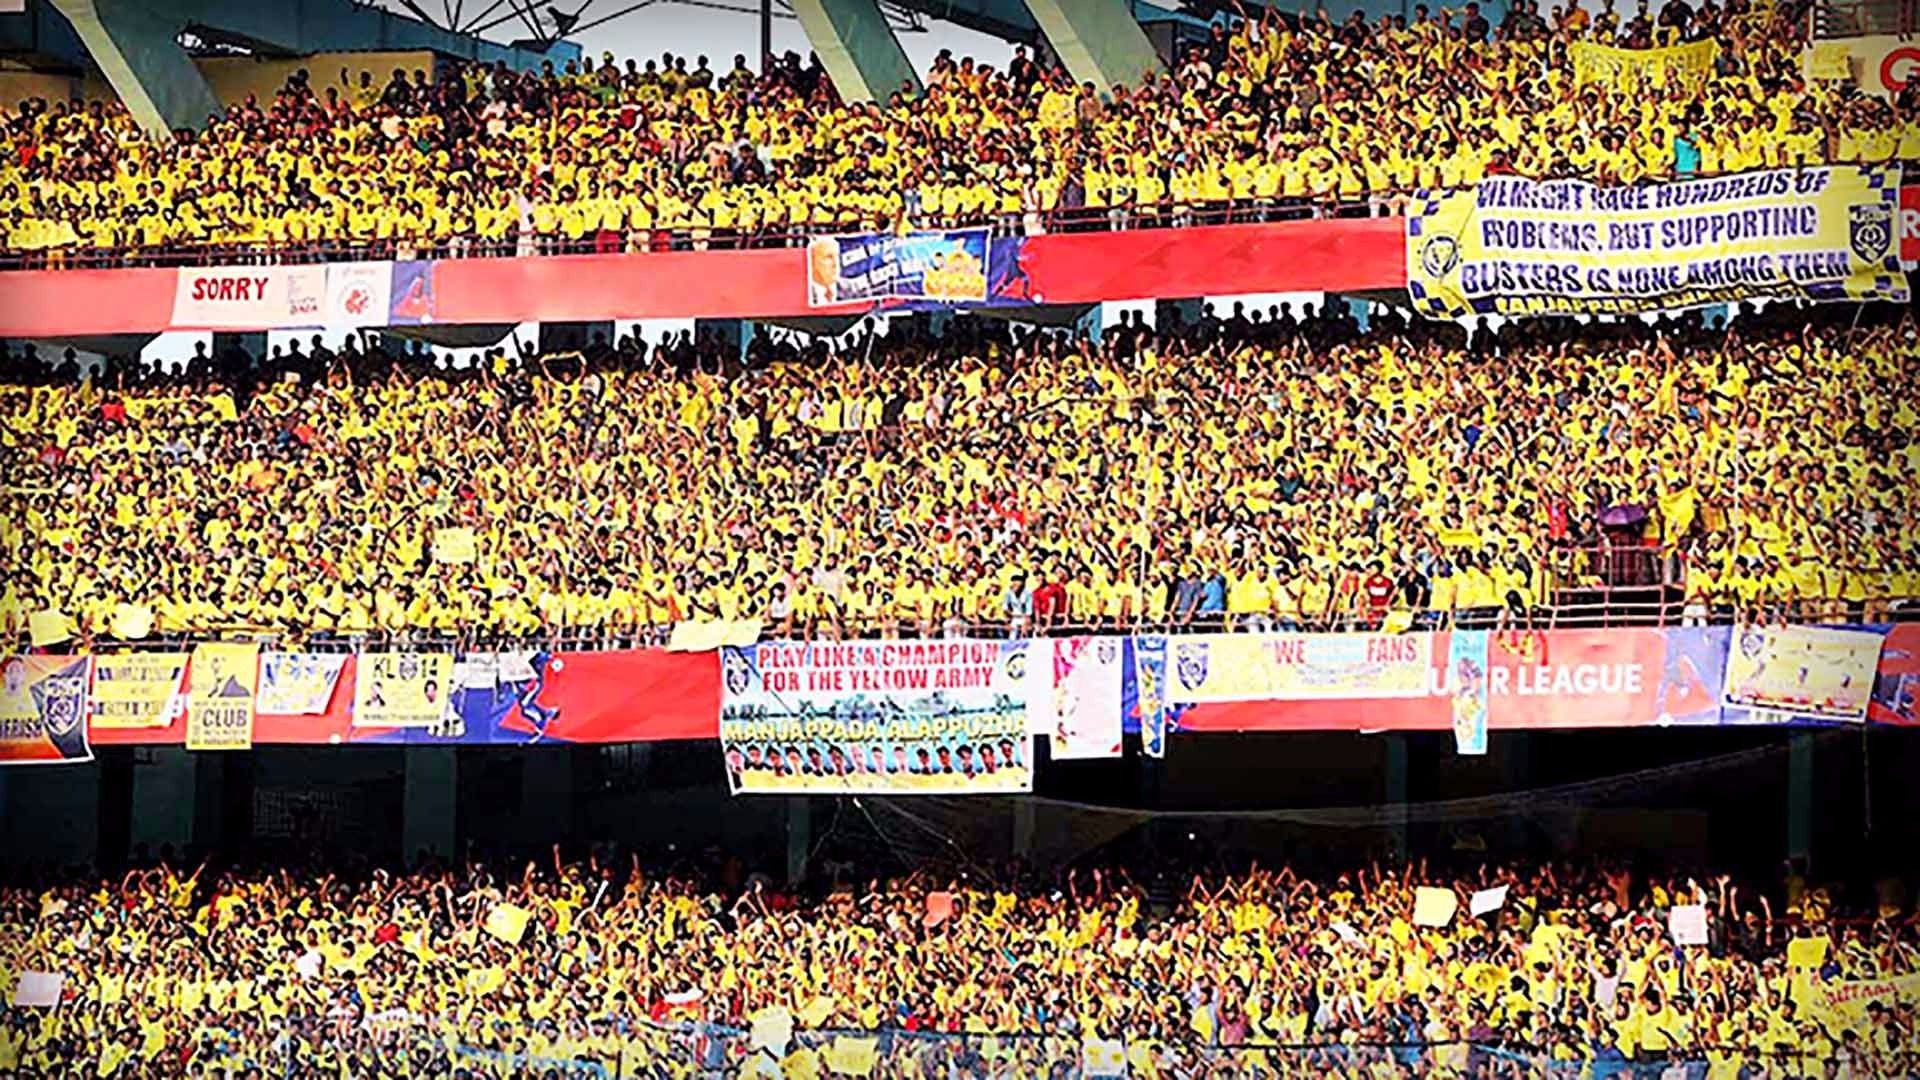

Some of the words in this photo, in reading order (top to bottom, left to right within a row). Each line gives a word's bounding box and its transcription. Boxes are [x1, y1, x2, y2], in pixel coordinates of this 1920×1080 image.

[1655, 172, 1792, 209] HUNDREDS
[1794, 170, 1830, 194] OF
[1608, 221, 1655, 250] BUT
[1661, 206, 1817, 249] SUPPORTING
[1462, 261, 1583, 293] BUSTERS
[1588, 268, 1615, 293] IS
[1618, 258, 1680, 294] NONE
[1686, 254, 1776, 287] AMONG
[1779, 250, 1851, 283] THEM
[192, 277, 269, 301] SORRY
[759, 647, 807, 668] PLAY
[813, 645, 856, 668] LIKE
[864, 647, 875, 667] A
[882, 643, 998, 666] CHAMPION
[1366, 637, 1417, 663] FANS
[763, 671, 800, 692] FOR
[808, 671, 842, 691] THE
[851, 668, 928, 691] YELLOW
[935, 667, 993, 688] ARMY
[1517, 664, 1642, 695] LEAGUE
[203, 708, 247, 728] CLUB
[724, 718, 880, 741] MANJAPPADA
